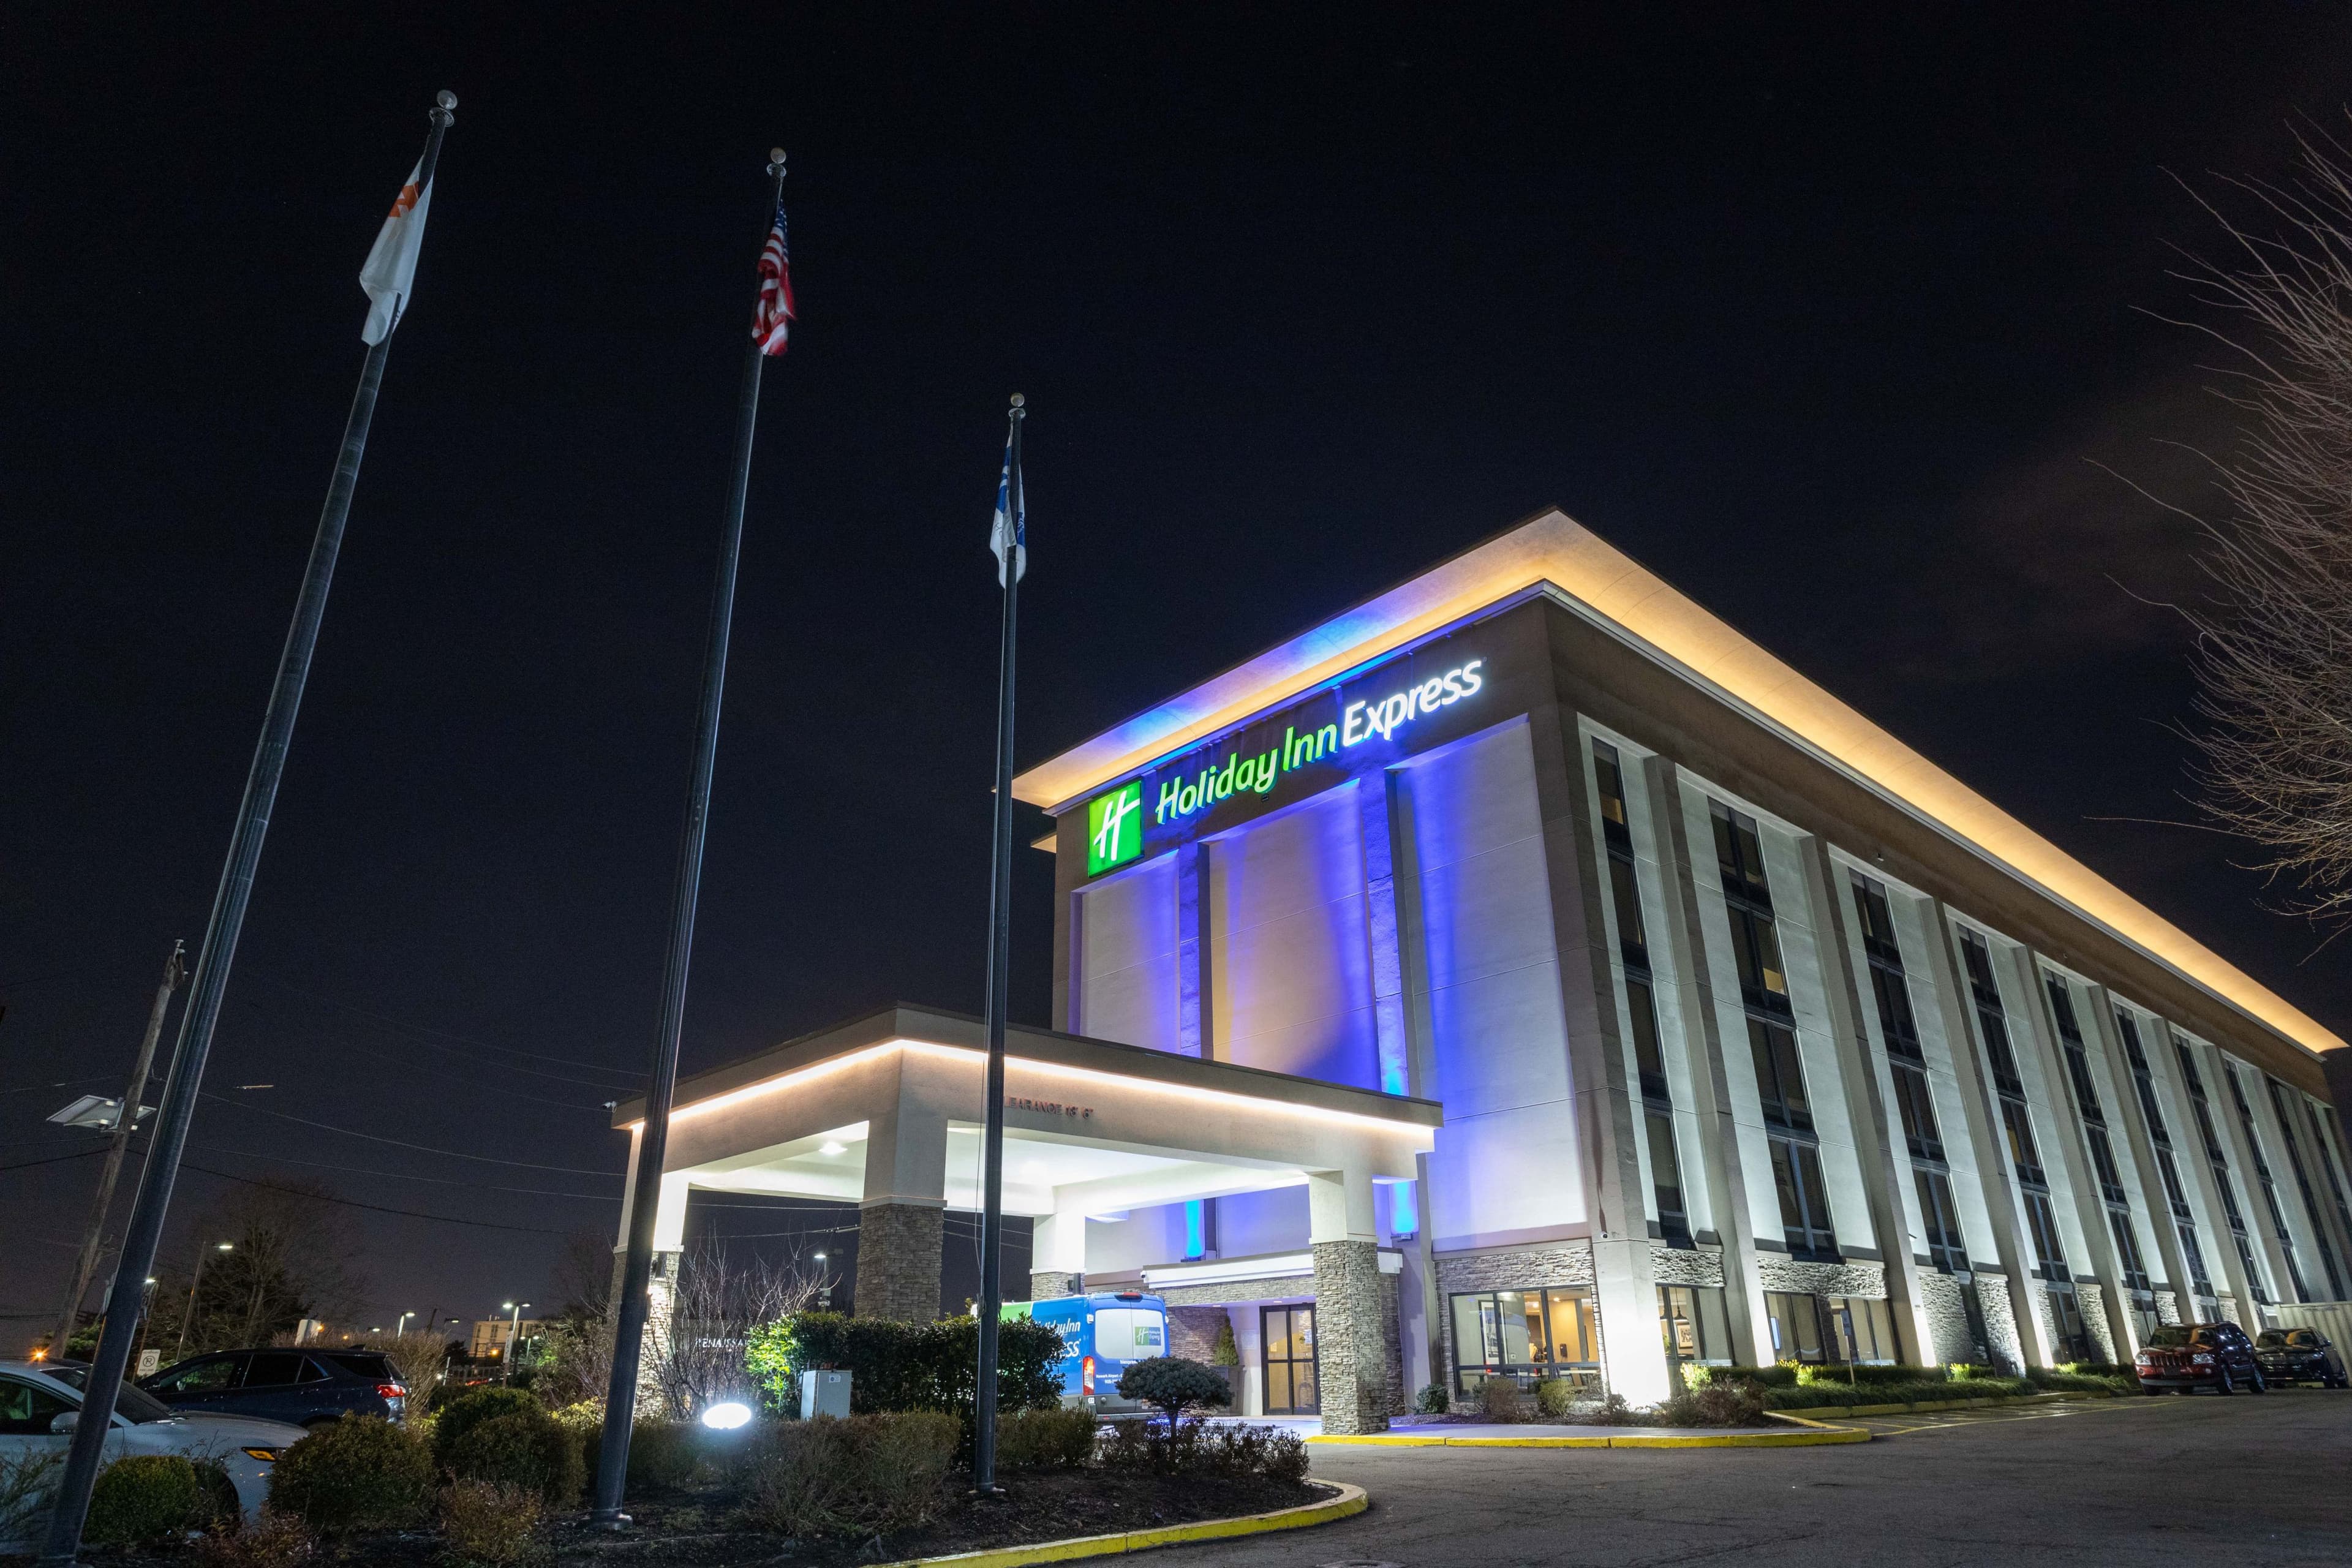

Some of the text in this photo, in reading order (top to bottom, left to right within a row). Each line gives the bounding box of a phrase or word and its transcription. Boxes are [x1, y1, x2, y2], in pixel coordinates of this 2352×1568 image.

[1155, 660, 1482, 824] Holiday Inn Express
[1066, 1318, 1080, 1333] Inn
